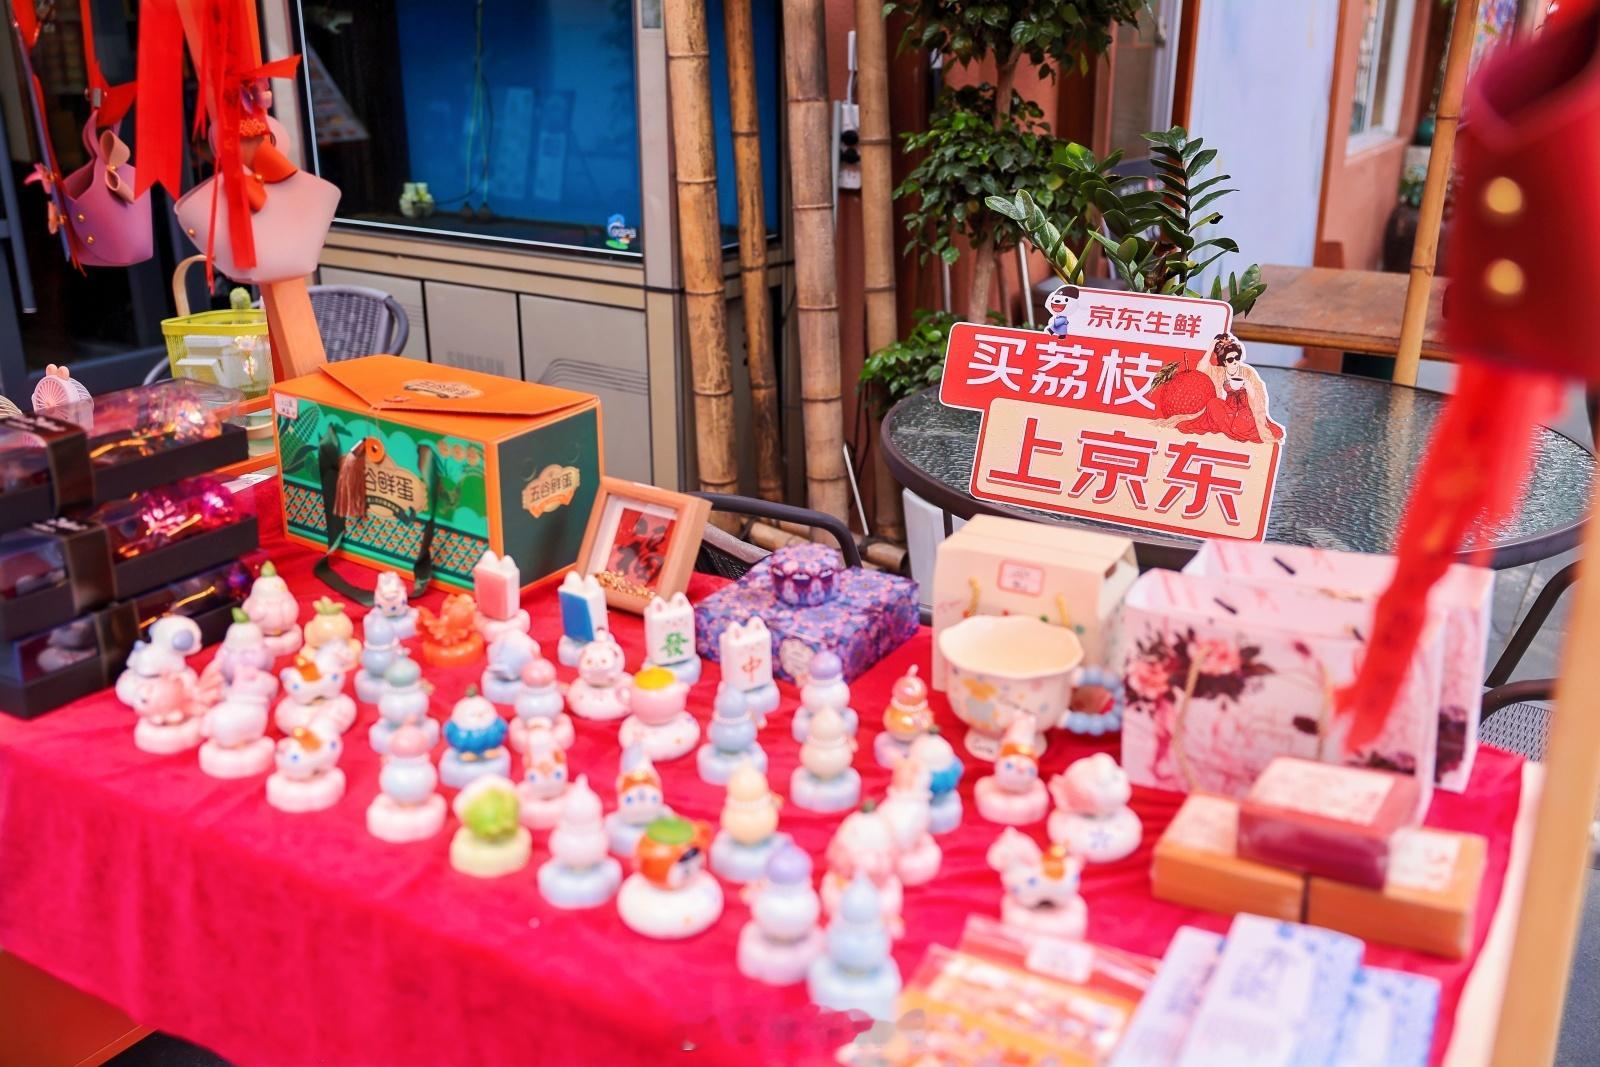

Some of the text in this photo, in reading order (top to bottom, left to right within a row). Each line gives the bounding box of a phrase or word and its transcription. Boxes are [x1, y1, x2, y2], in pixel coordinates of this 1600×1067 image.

[1087, 305, 1202, 339] 京东生鲜
[966, 333, 1165, 411] 买荔枝
[365, 467, 414, 502] 谷鲜蛋
[986, 417, 1251, 526] 上京东
